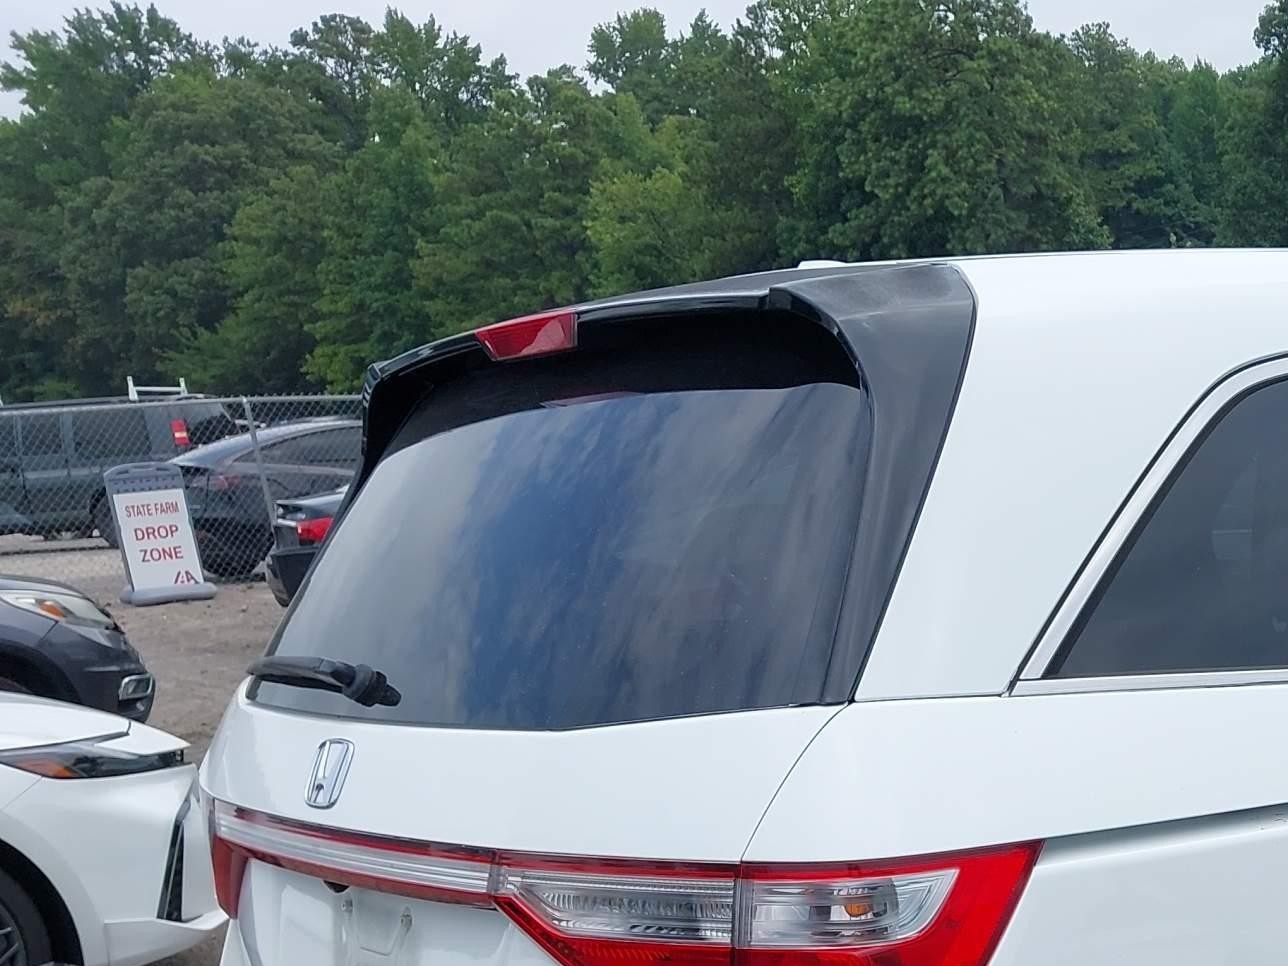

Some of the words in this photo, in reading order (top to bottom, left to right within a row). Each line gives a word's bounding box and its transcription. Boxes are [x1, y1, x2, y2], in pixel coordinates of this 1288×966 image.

[124, 503, 153, 518] STATE
[153, 501, 180, 516] FARM
[134, 524, 179, 541] DROP
[139, 545, 184, 563] ZONE
